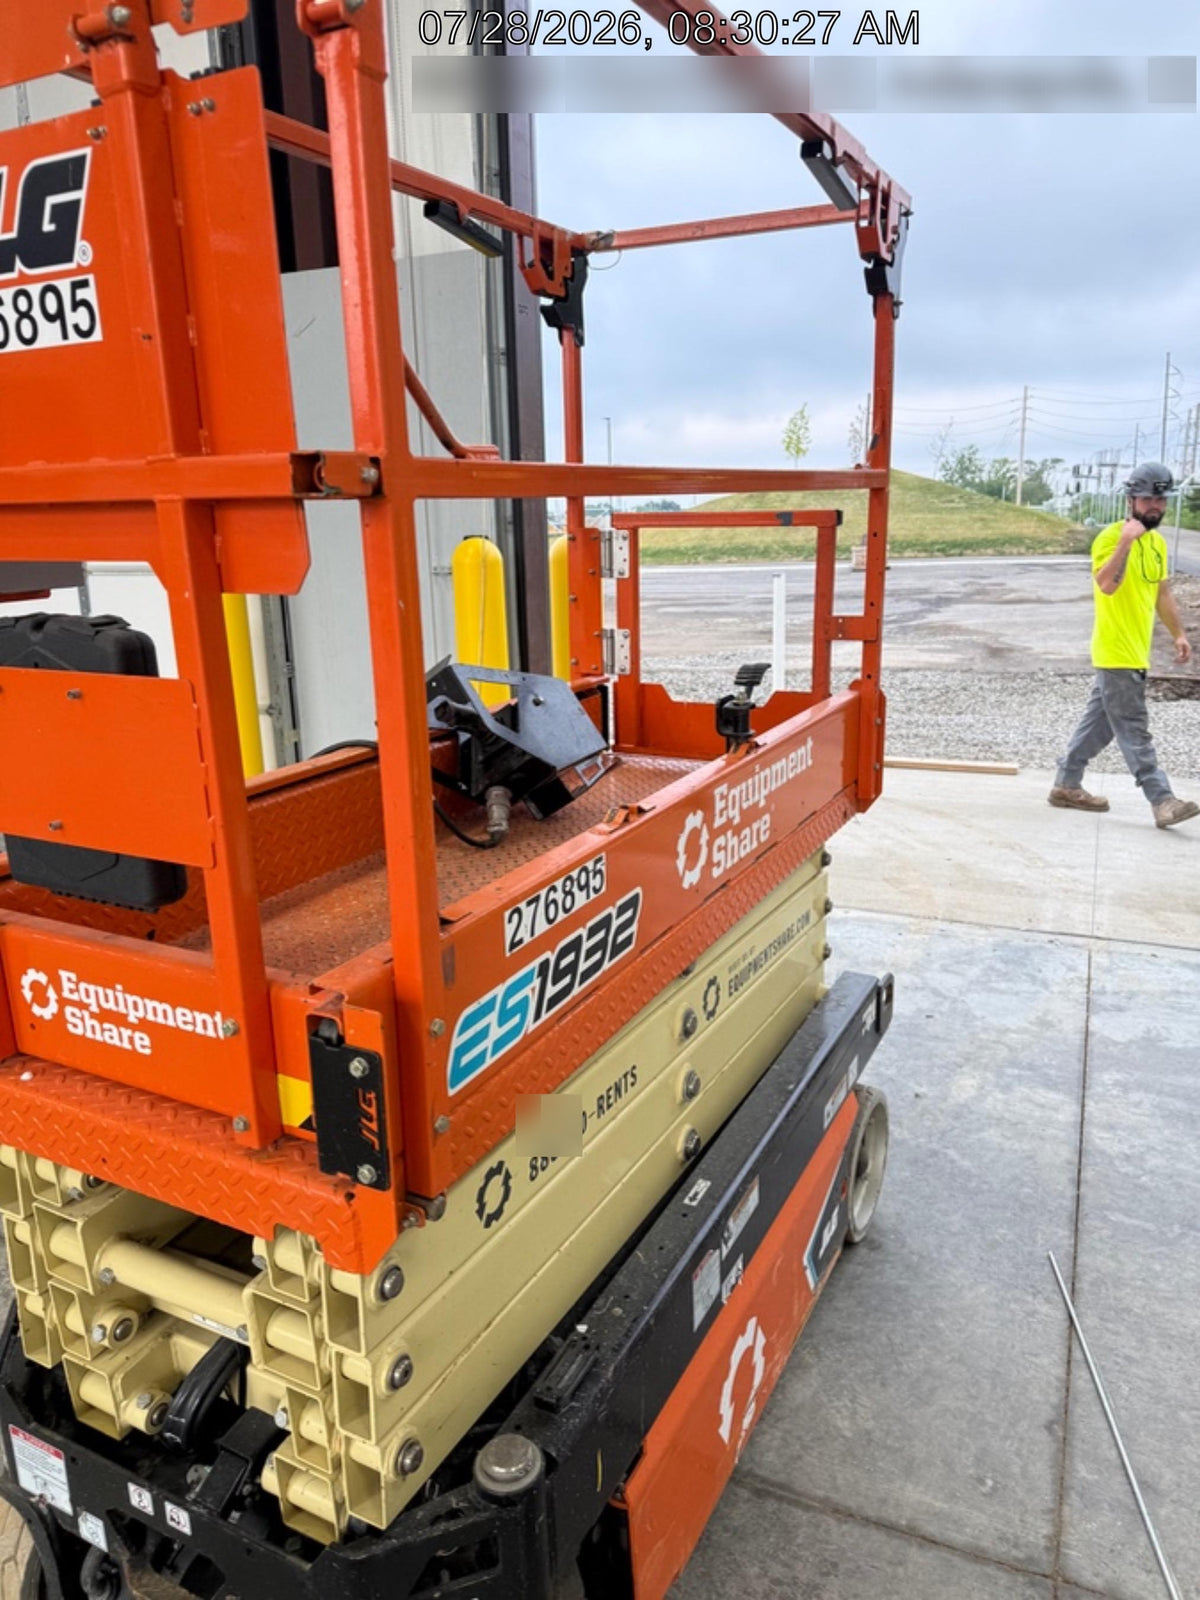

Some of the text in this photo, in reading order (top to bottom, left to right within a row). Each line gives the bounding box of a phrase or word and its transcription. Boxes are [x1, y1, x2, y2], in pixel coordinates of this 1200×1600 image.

[713, 736, 813, 829] Equipment
[711, 813, 771, 878] Share
[507, 855, 605, 953] 276895
[64, 1004, 152, 1055] Share
[448, 889, 641, 1093] ES1932
